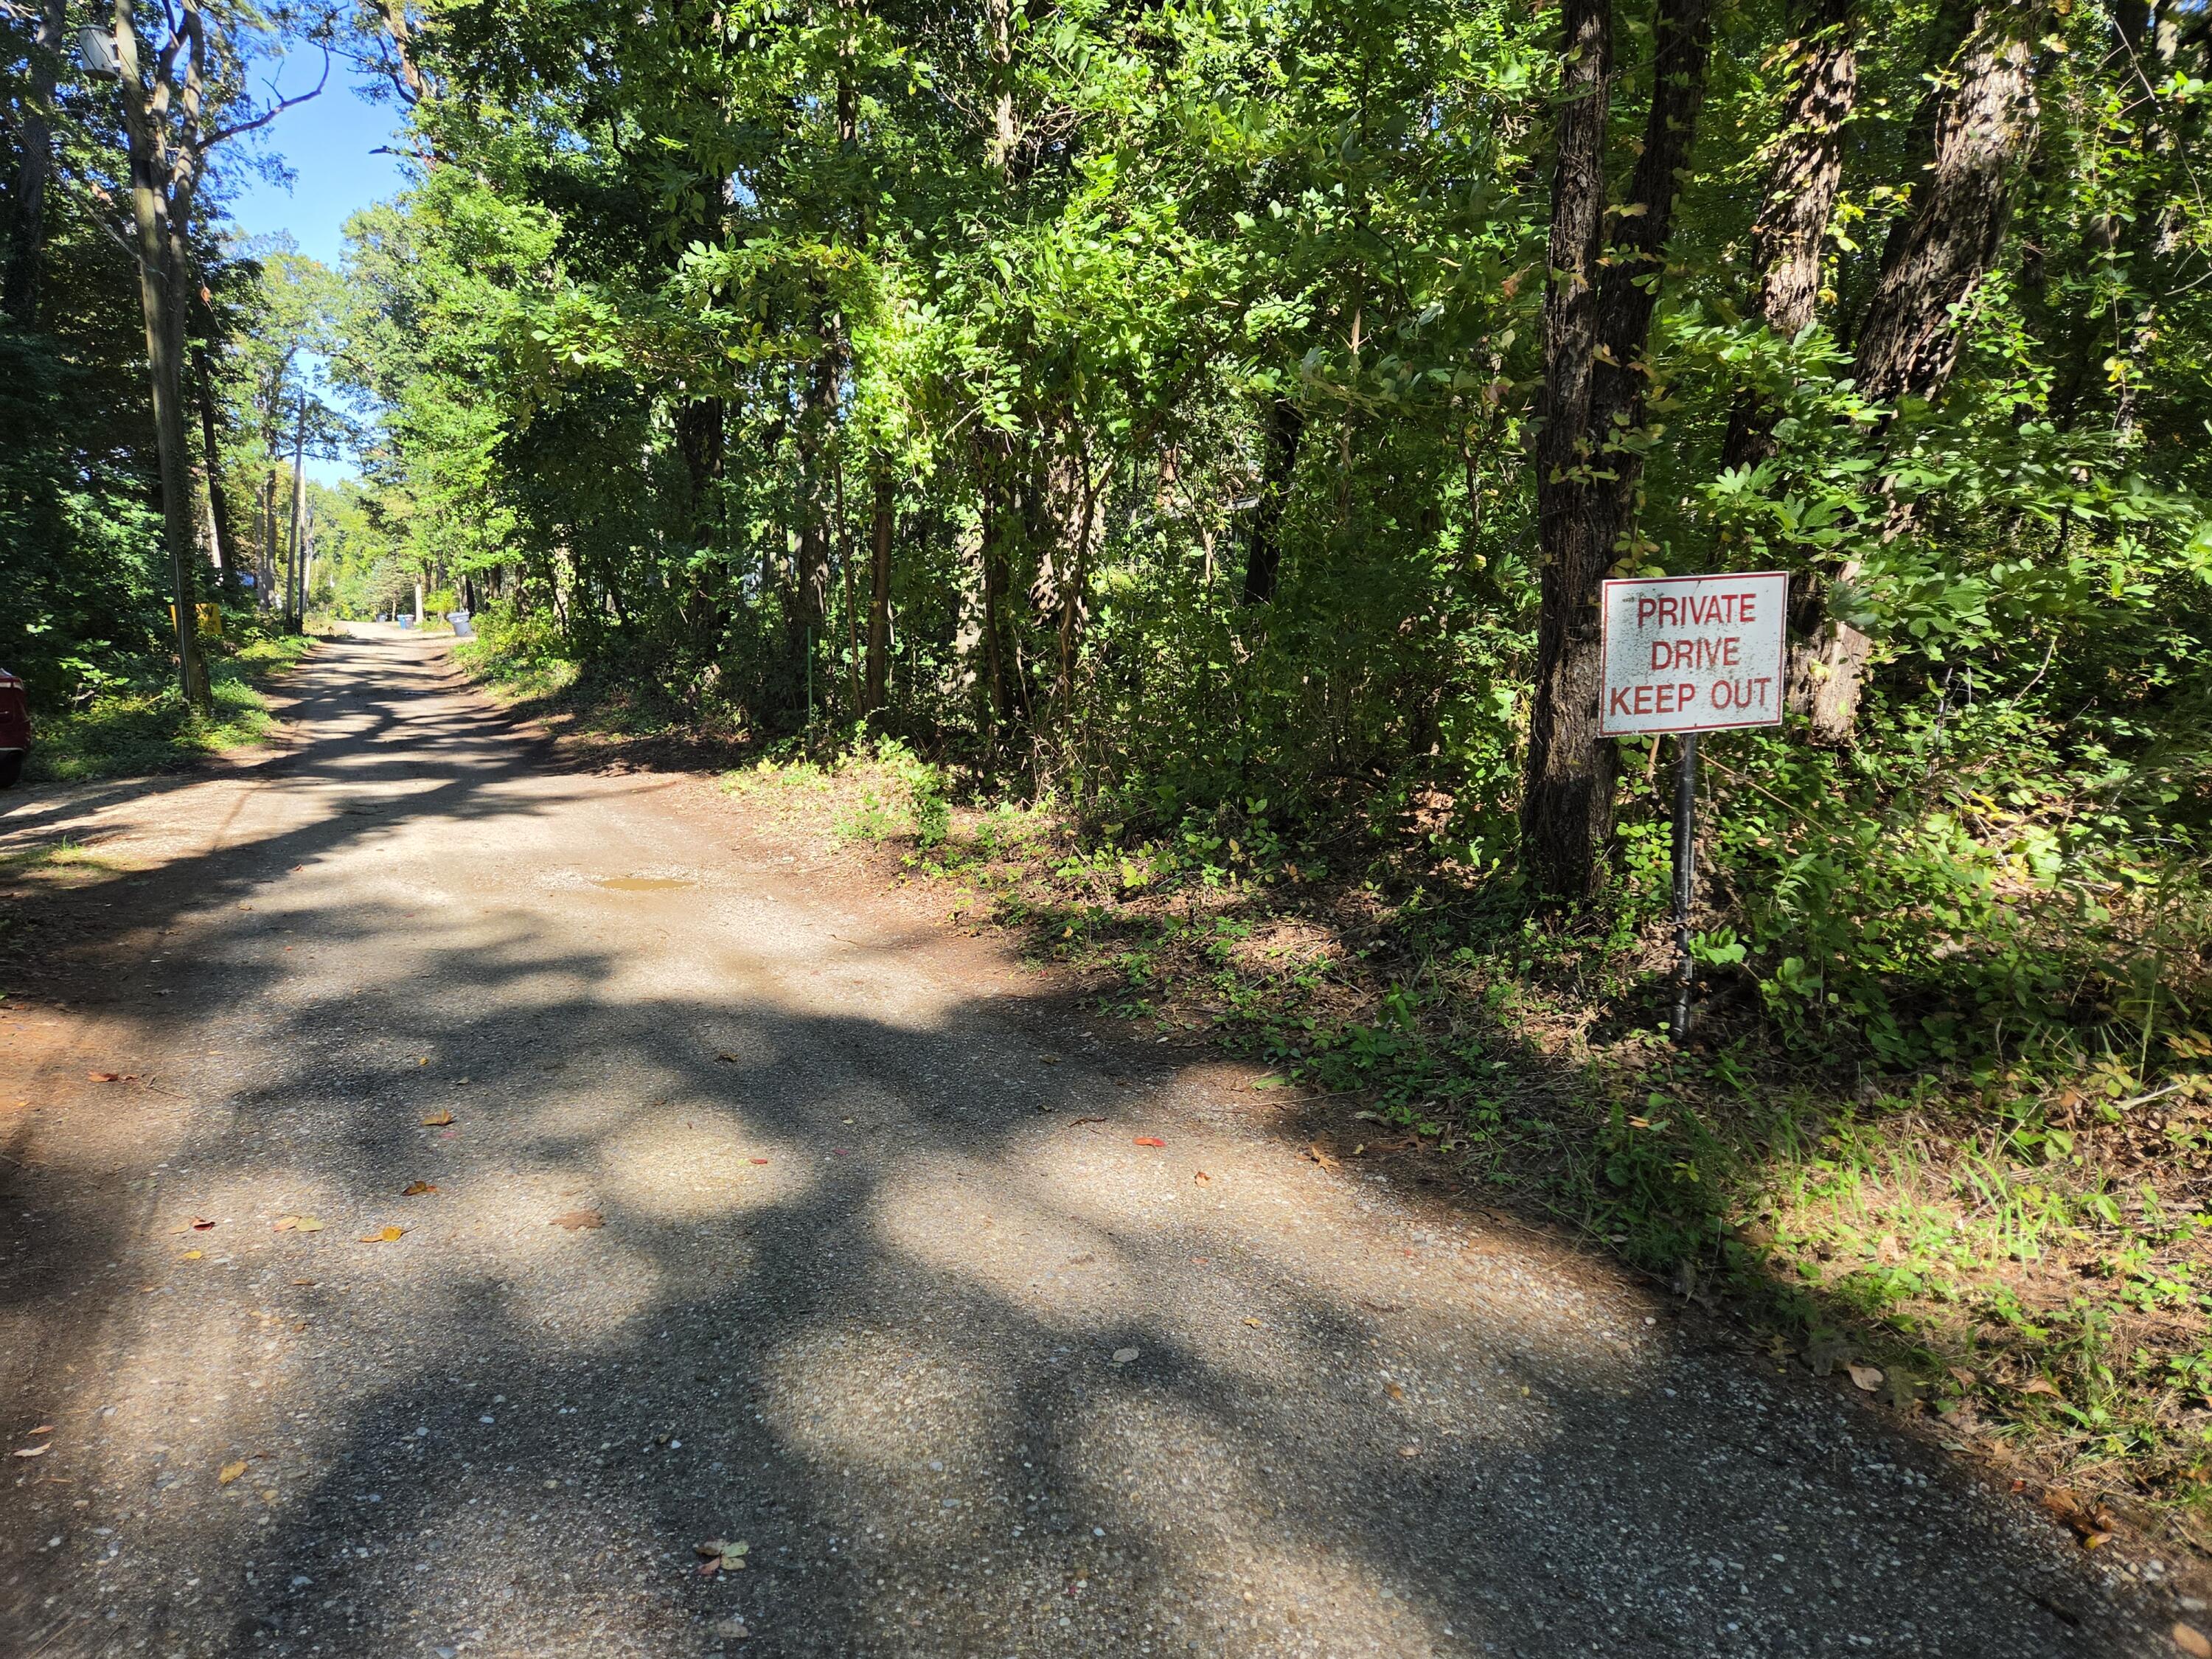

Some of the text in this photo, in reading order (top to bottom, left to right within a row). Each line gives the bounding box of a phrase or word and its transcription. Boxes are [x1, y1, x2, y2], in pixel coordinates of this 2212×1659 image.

[1638, 593, 1757, 627] PRIVATE
[1652, 637, 1740, 670] DRIVE
[1610, 678, 1772, 716] KEEP OUT
